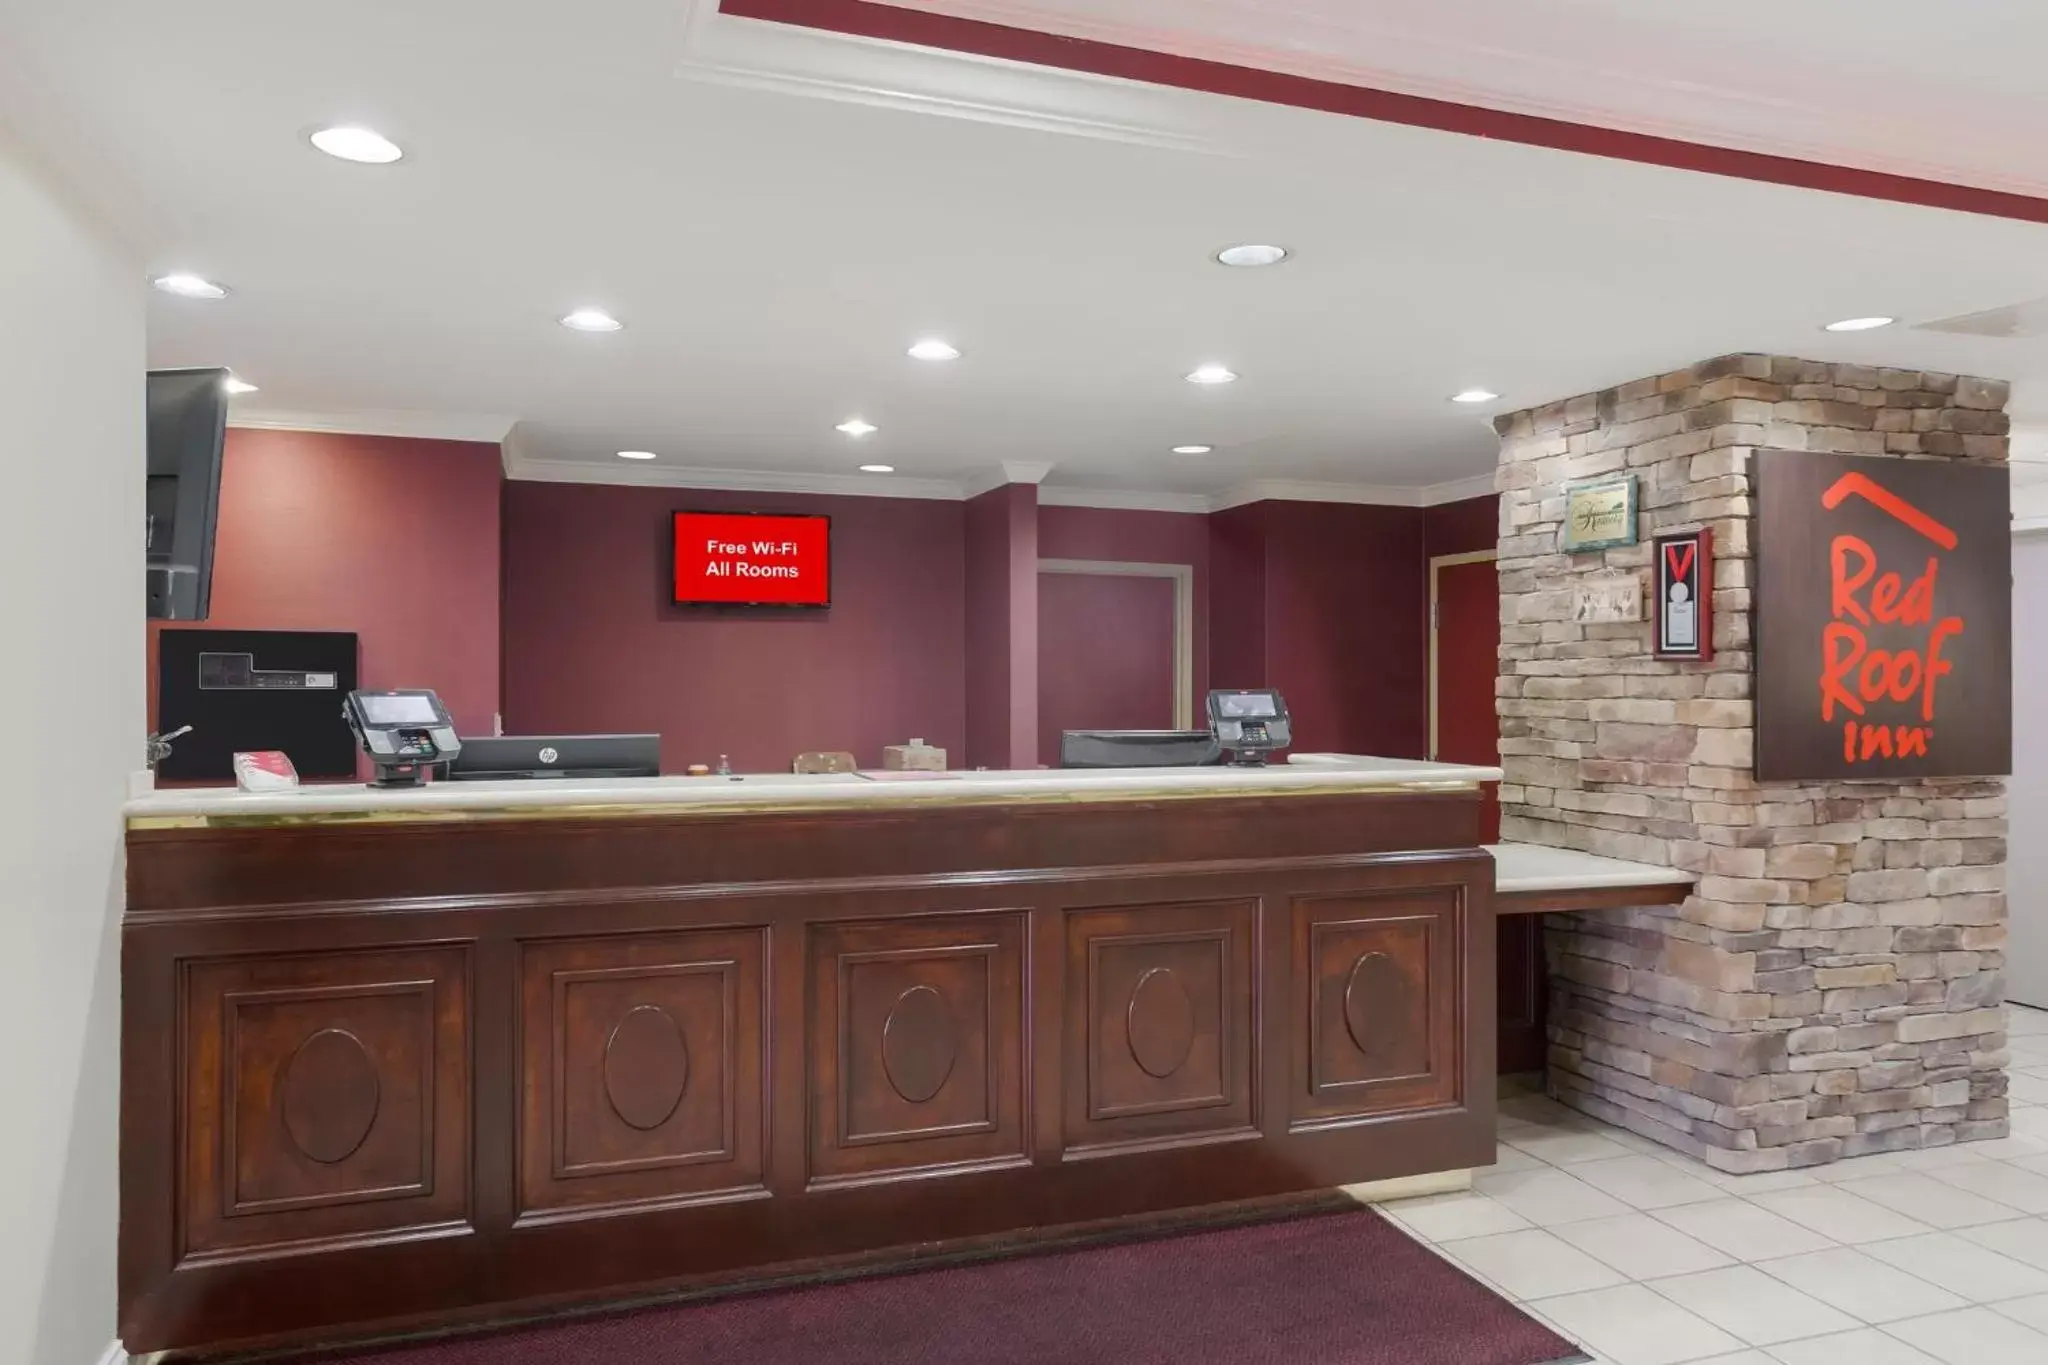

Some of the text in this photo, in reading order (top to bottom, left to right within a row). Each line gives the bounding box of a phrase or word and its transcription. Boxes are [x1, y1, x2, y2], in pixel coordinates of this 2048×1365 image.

[707, 540, 798, 556] Free Wi-Fi
[706, 561, 800, 578] All Rooms
[1831, 535, 1939, 628] Red
[1820, 616, 1964, 722] Roof
[539, 747, 558, 764] hp
